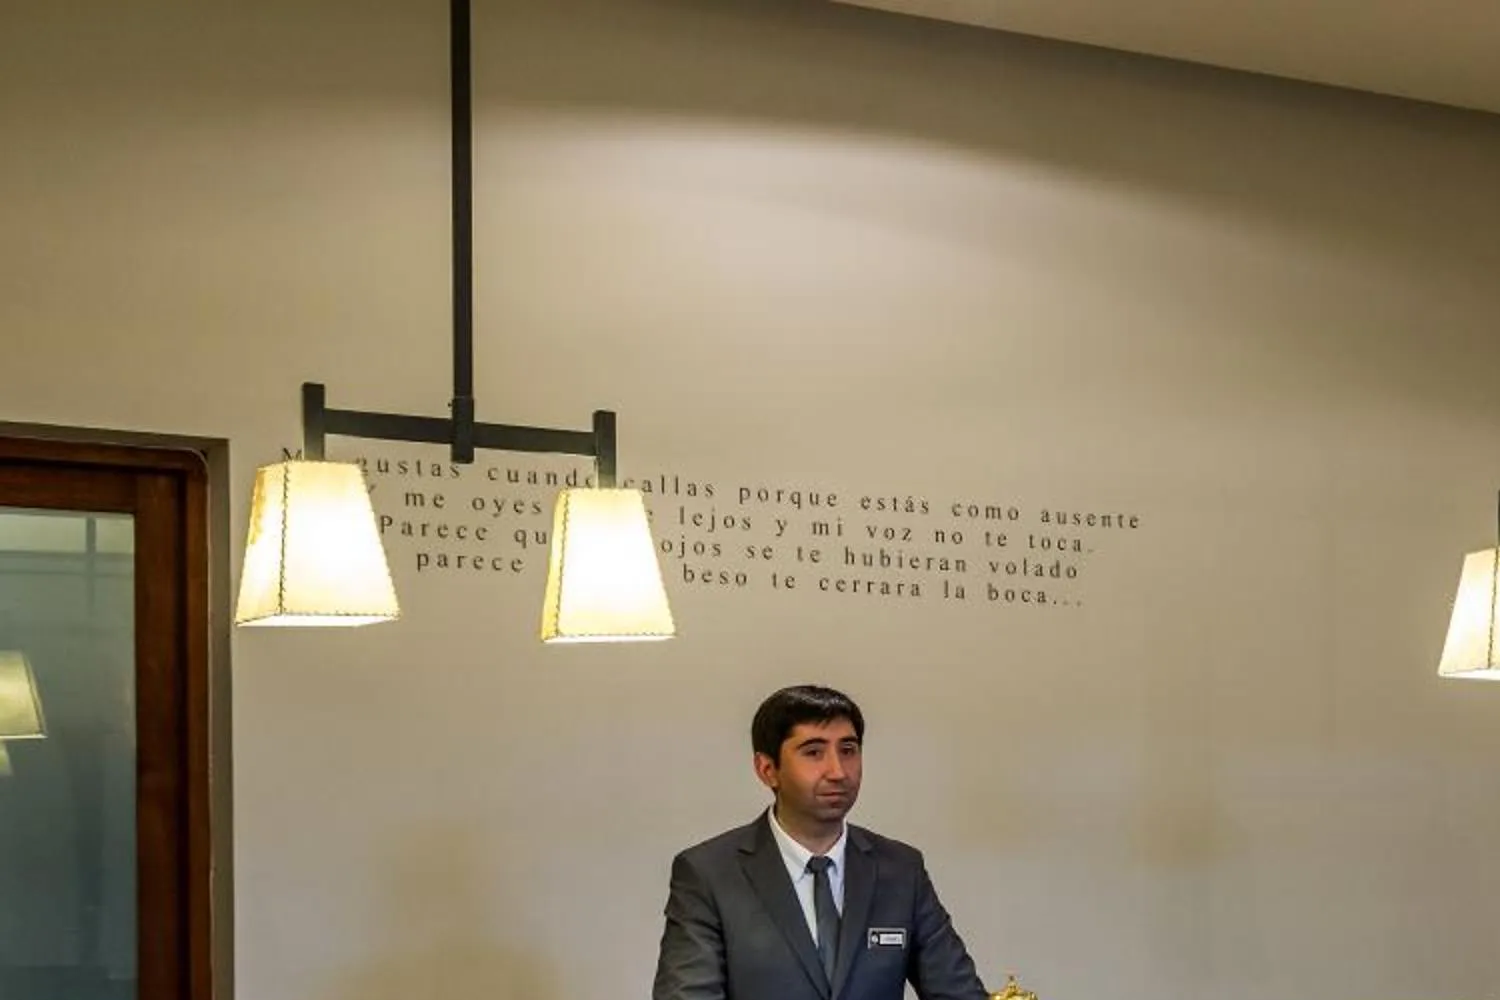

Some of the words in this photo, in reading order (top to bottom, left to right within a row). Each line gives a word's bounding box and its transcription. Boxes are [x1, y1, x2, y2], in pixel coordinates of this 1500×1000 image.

[405, 493, 444, 509] me
[472, 498, 542, 518] oyes
[680, 506, 751, 532] lejos
[776, 520, 787, 537] y
[812, 517, 842, 536] mi
[866, 526, 911, 542] voz
[935, 531, 963, 544] no
[985, 532, 1007, 547] te
[740, 488, 836, 509] porque
[861, 496, 928, 514] estás
[952, 504, 1019, 520] como
[1041, 510, 1138, 528] ausente
[379, 515, 487, 541] Parece
[513, 527, 548, 550] qu
[661, 535, 720, 559] ojos
[746, 546, 772, 560] se
[797, 547, 820, 563] te
[845, 546, 966, 572] hubieran
[989, 558, 1077, 578] volado
[417, 553, 522, 573] parece
[683, 563, 747, 586] beso
[772, 573, 795, 589] te
[819, 578, 920, 596] cerrara
[944, 580, 965, 599] la
